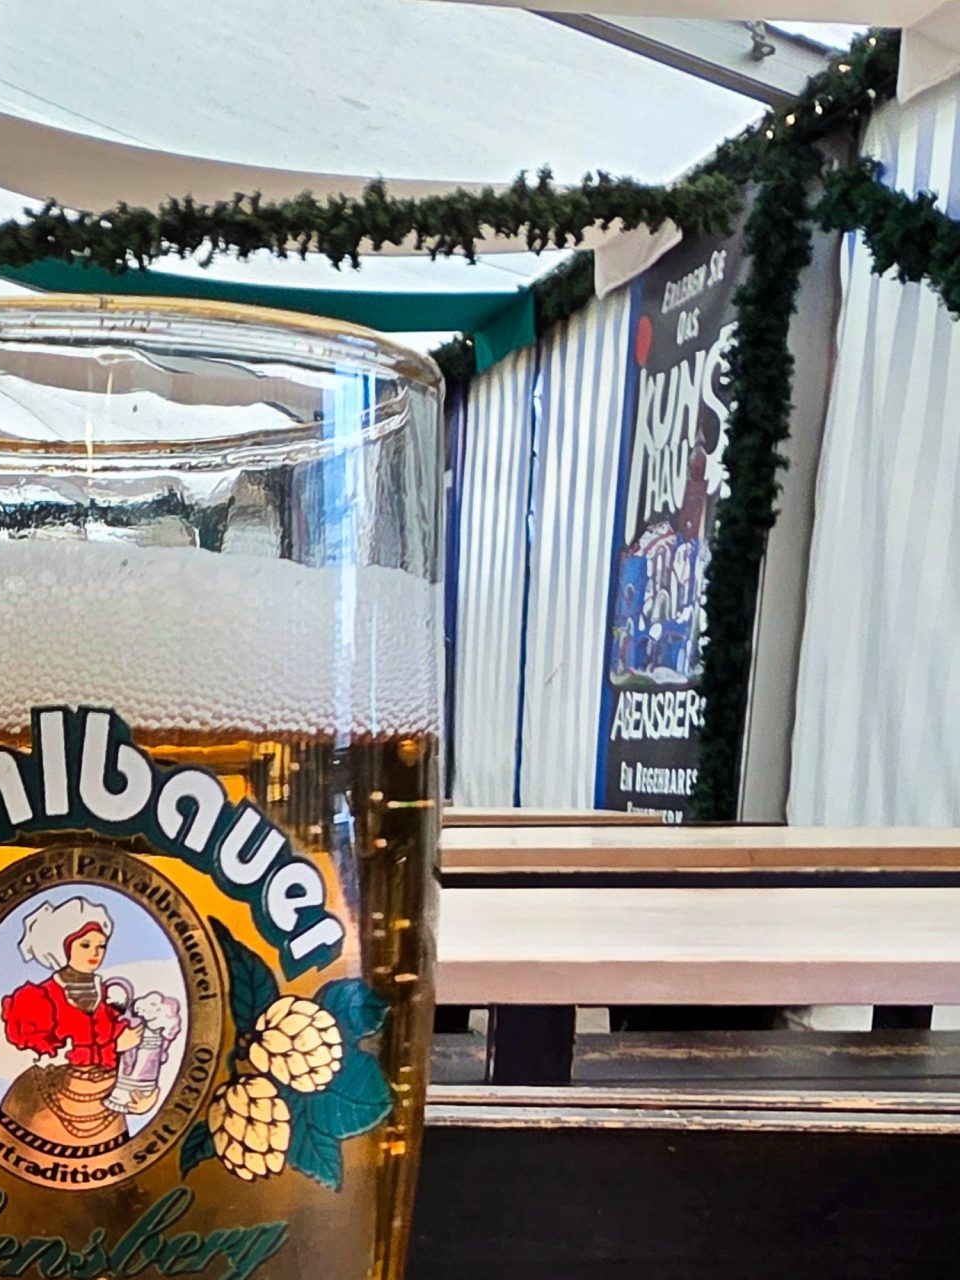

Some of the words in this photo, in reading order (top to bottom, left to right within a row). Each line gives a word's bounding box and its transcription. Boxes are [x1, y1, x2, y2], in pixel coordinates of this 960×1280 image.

[76, 855, 218, 1001] Privatbrauerei
[133, 1122, 177, 1165] seit
[178, 1047, 213, 1113] 1300
